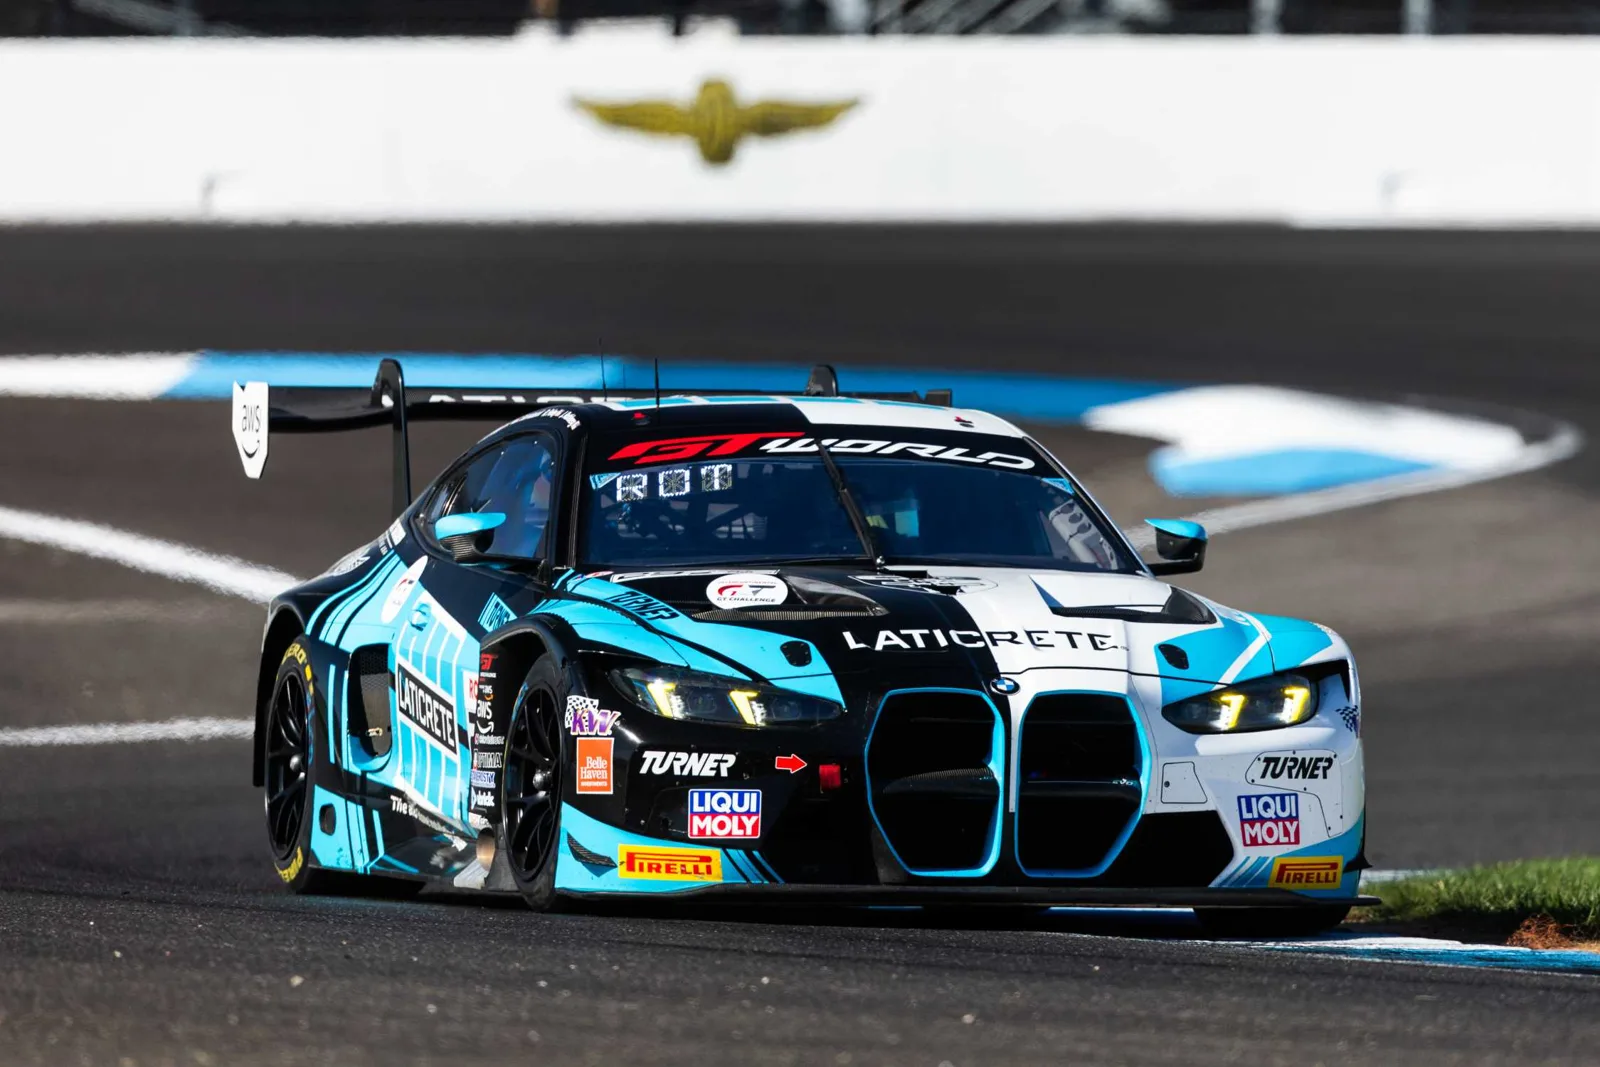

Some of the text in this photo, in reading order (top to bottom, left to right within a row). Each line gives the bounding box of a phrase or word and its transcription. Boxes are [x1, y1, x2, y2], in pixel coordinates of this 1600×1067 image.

[241, 403, 262, 433] aws
[607, 431, 1036, 470] GT WORLD
[605, 591, 680, 621] TURNER
[841, 628, 1119, 651] LATICRETE
[398, 671, 456, 748] LATICRETE
[476, 699, 493, 720] aws
[580, 767, 608, 780] Haven
[586, 756, 608, 769] Belle
[639, 750, 738, 778] TURNER
[1260, 757, 1333, 779] TURNER
[390, 795, 408, 815] The
[692, 791, 758, 814] LIQUI
[1240, 796, 1296, 818] LIQUI
[692, 815, 760, 836] MOLY
[1244, 822, 1298, 844] MOLY
[626, 851, 713, 876] PIRELLI
[1275, 861, 1339, 884] PIRELLI
